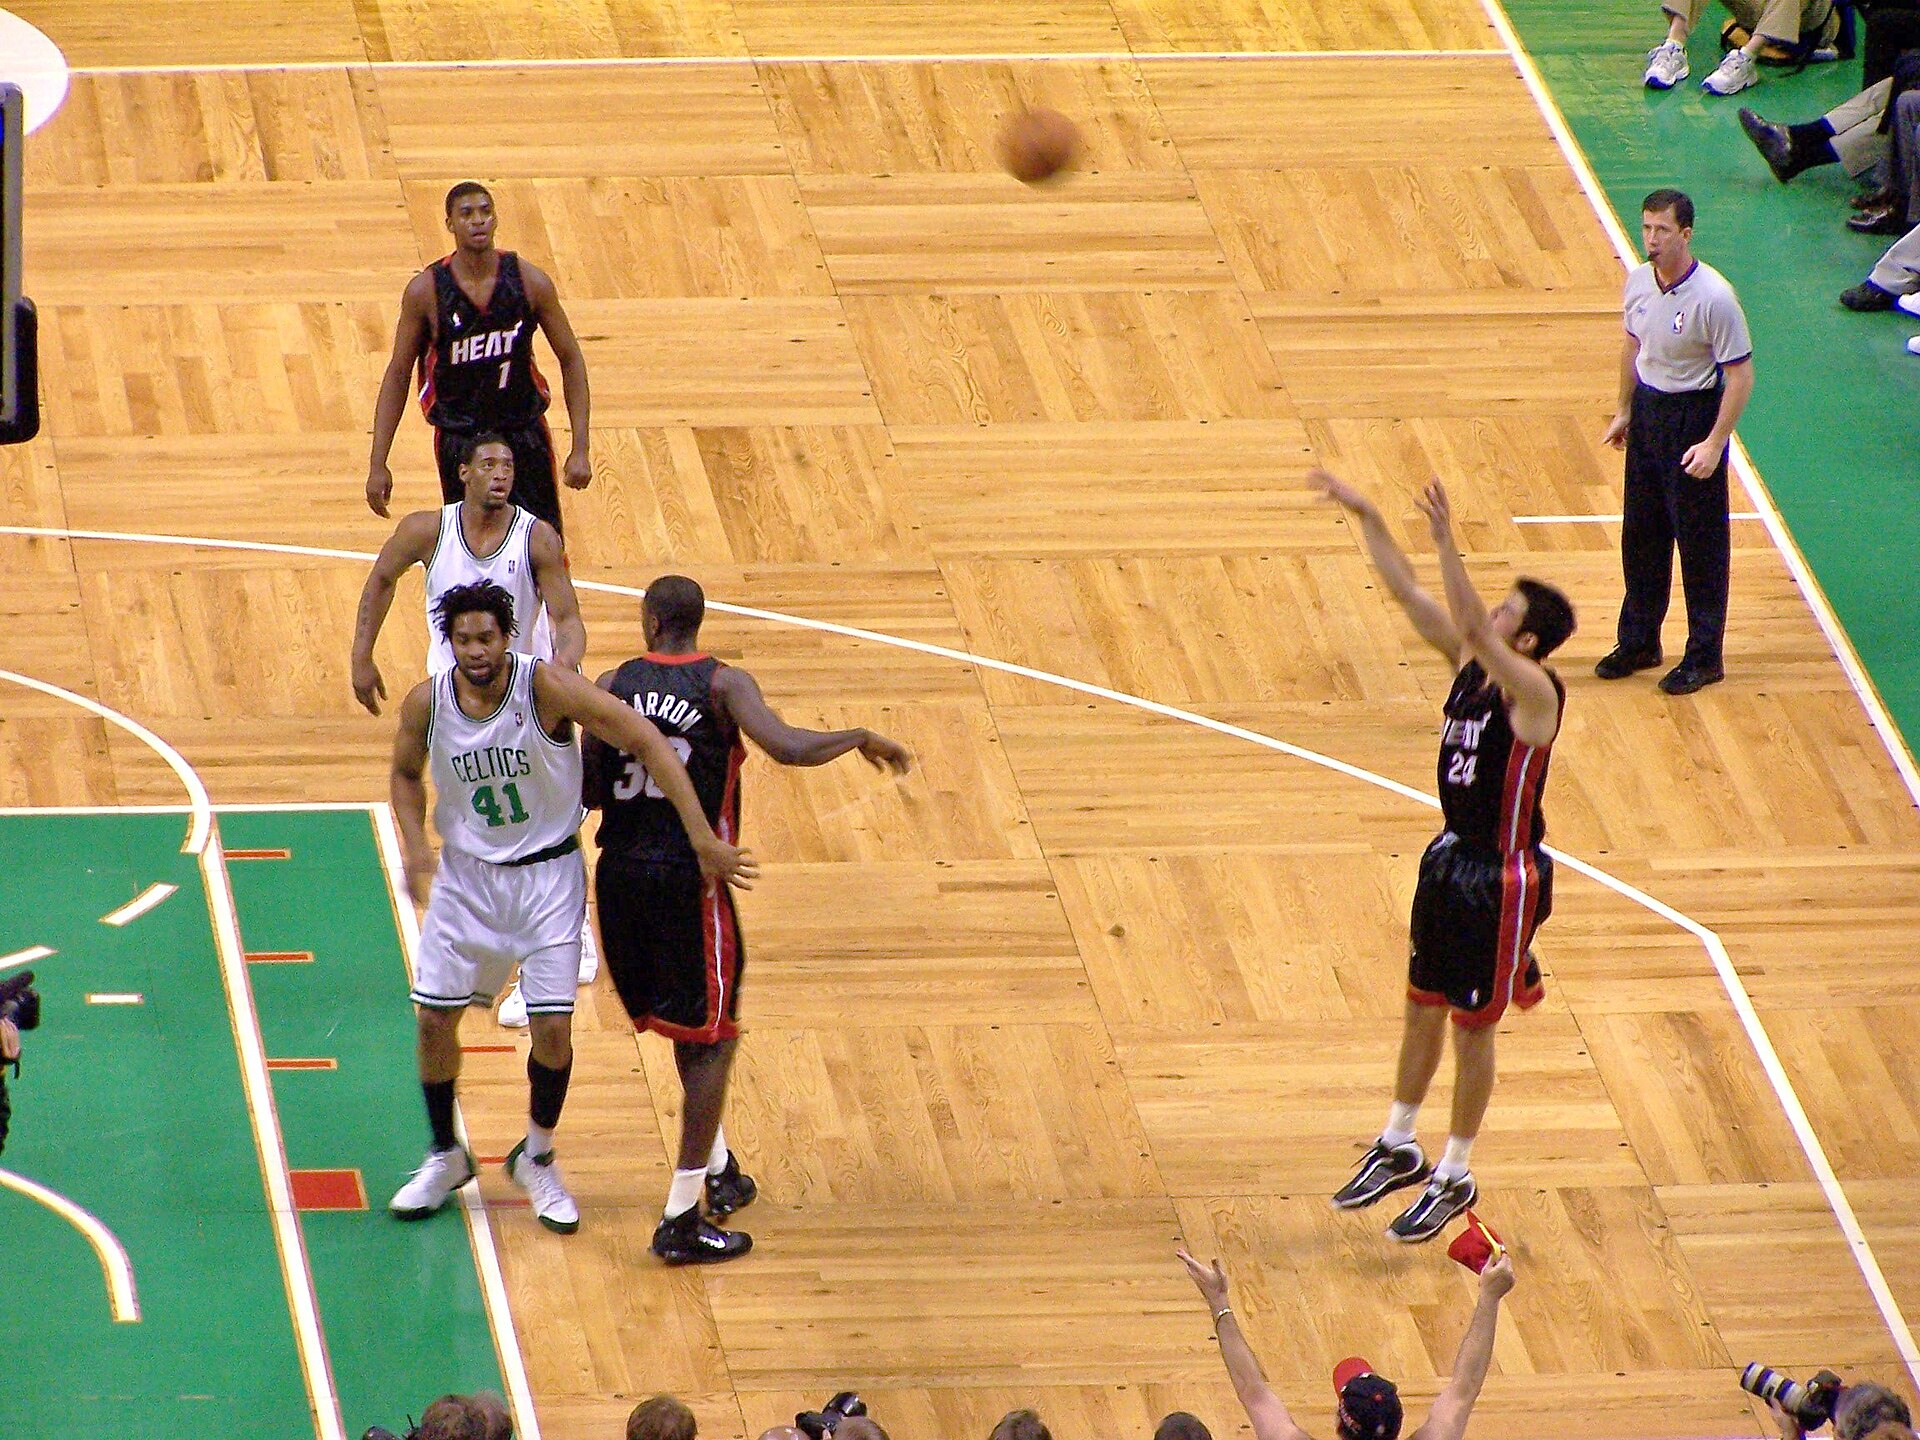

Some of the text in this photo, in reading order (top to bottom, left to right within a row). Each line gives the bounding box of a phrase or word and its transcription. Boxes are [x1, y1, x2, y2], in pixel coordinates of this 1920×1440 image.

[451, 320, 523, 365] HEAT
[498, 361, 511, 389] 1
[621, 691, 703, 732] ARRON
[451, 747, 531, 782] CELTICS
[1448, 751, 1478, 787] 24
[471, 783, 530, 826] 41
